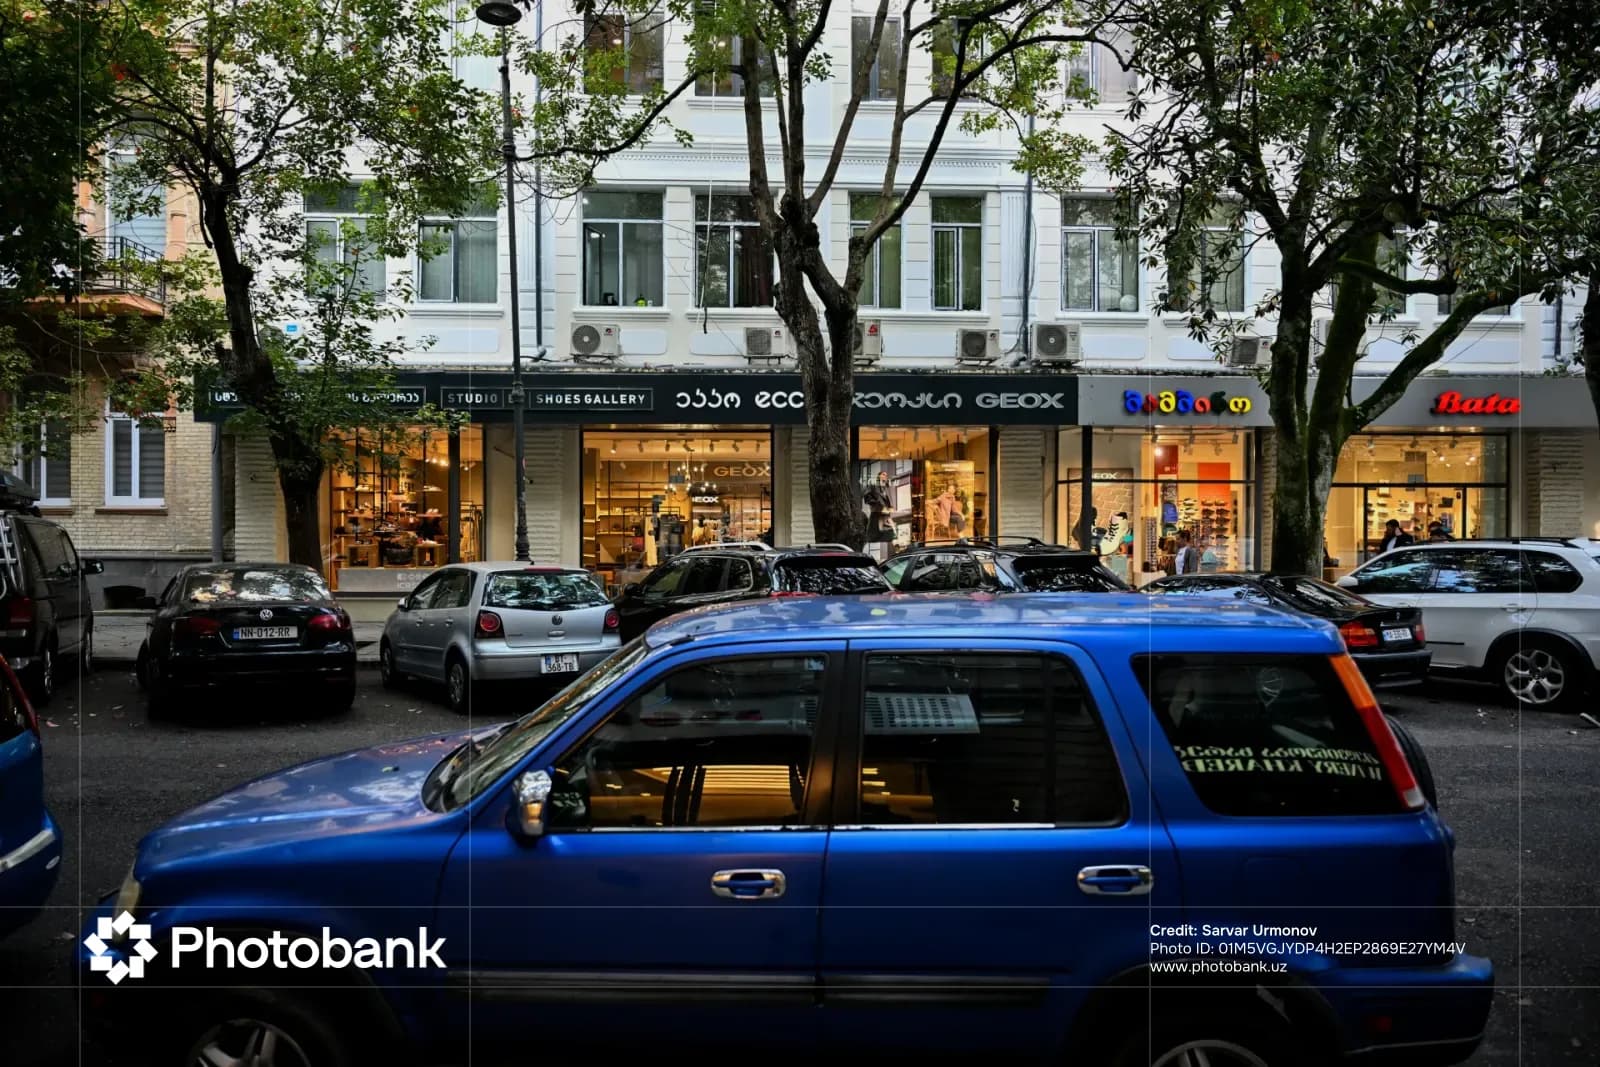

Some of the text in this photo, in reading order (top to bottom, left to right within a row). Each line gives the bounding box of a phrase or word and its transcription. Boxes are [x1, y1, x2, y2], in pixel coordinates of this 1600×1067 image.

[447, 393, 498, 404] STUDIO
[535, 394, 581, 404] SHOES
[584, 394, 646, 404] GALLERY
[755, 391, 805, 408] ecc
[975, 392, 1065, 409] GEOX
[1432, 389, 1521, 414] Bata
[713, 465, 770, 477] GEOX
[1091, 471, 1119, 480] EOX
[240, 627, 290, 639] NN-012-RR
